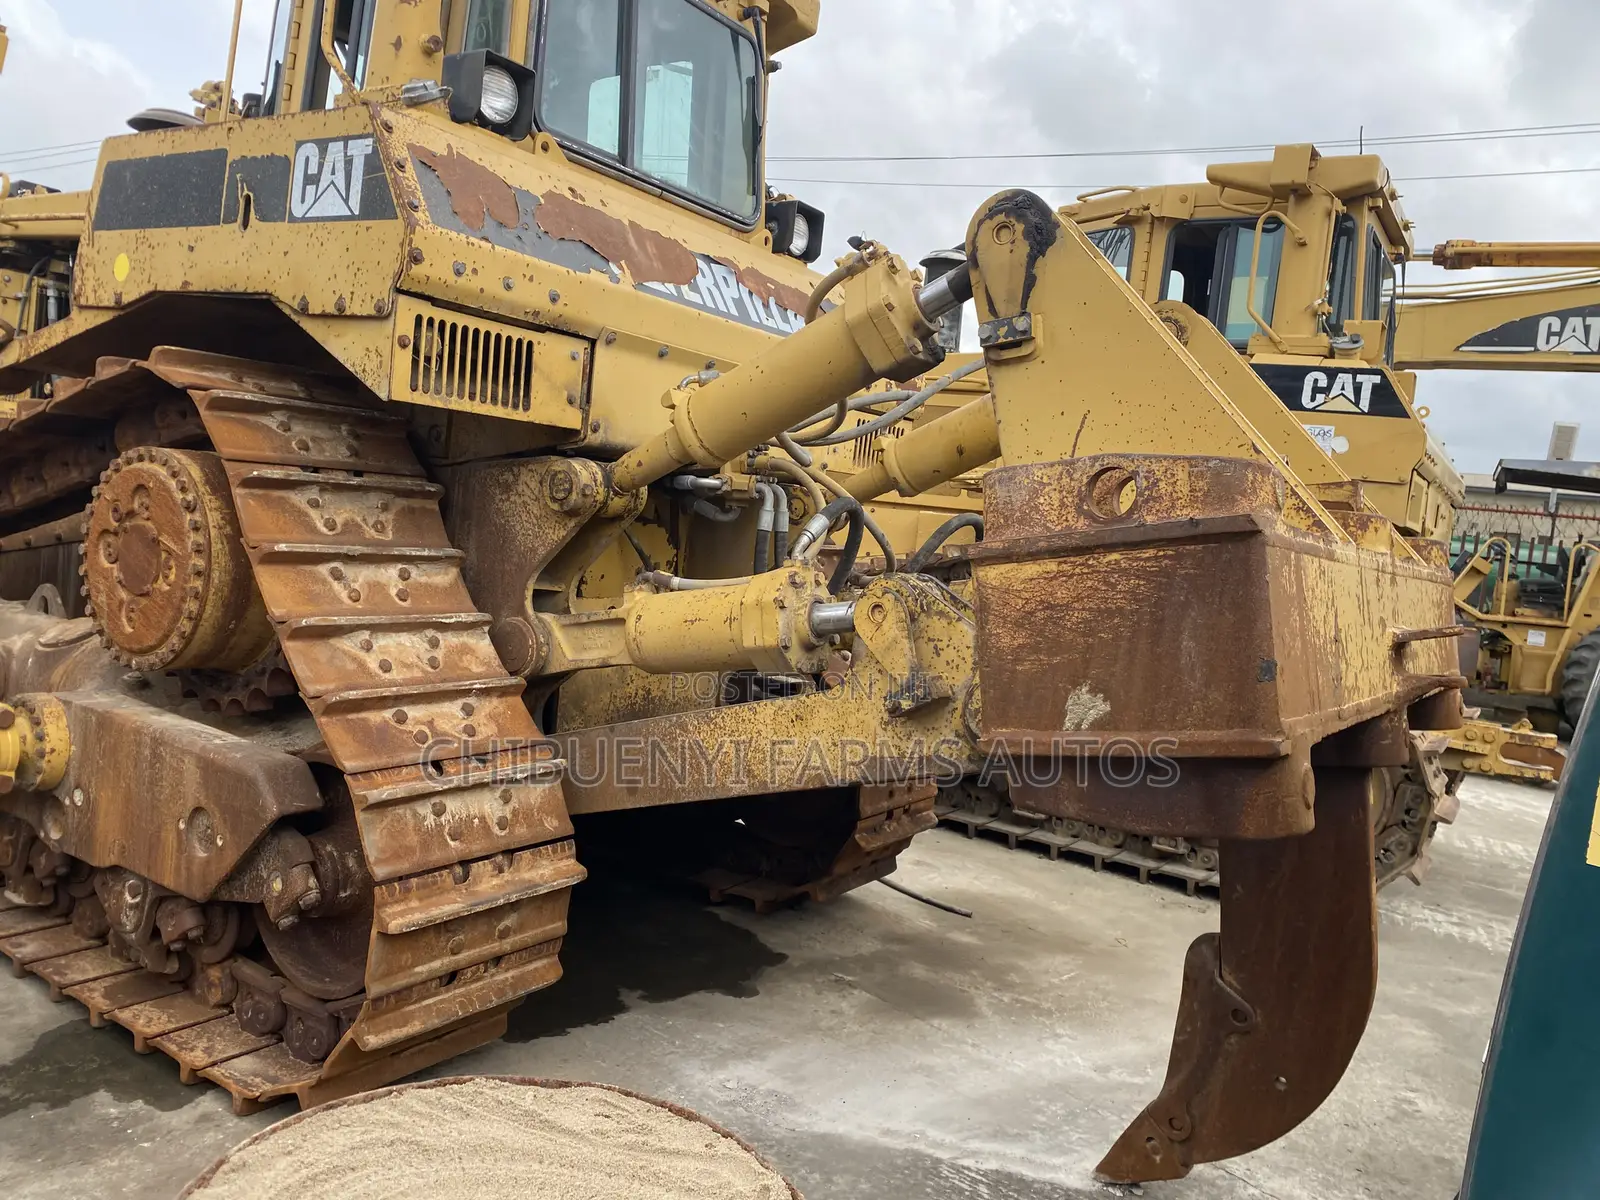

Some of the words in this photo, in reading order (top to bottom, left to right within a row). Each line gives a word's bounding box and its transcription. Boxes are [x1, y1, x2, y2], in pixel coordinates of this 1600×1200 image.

[291, 138, 373, 217] CAT
[1536, 315, 1600, 352] CAT
[1301, 371, 1381, 413] CAT
